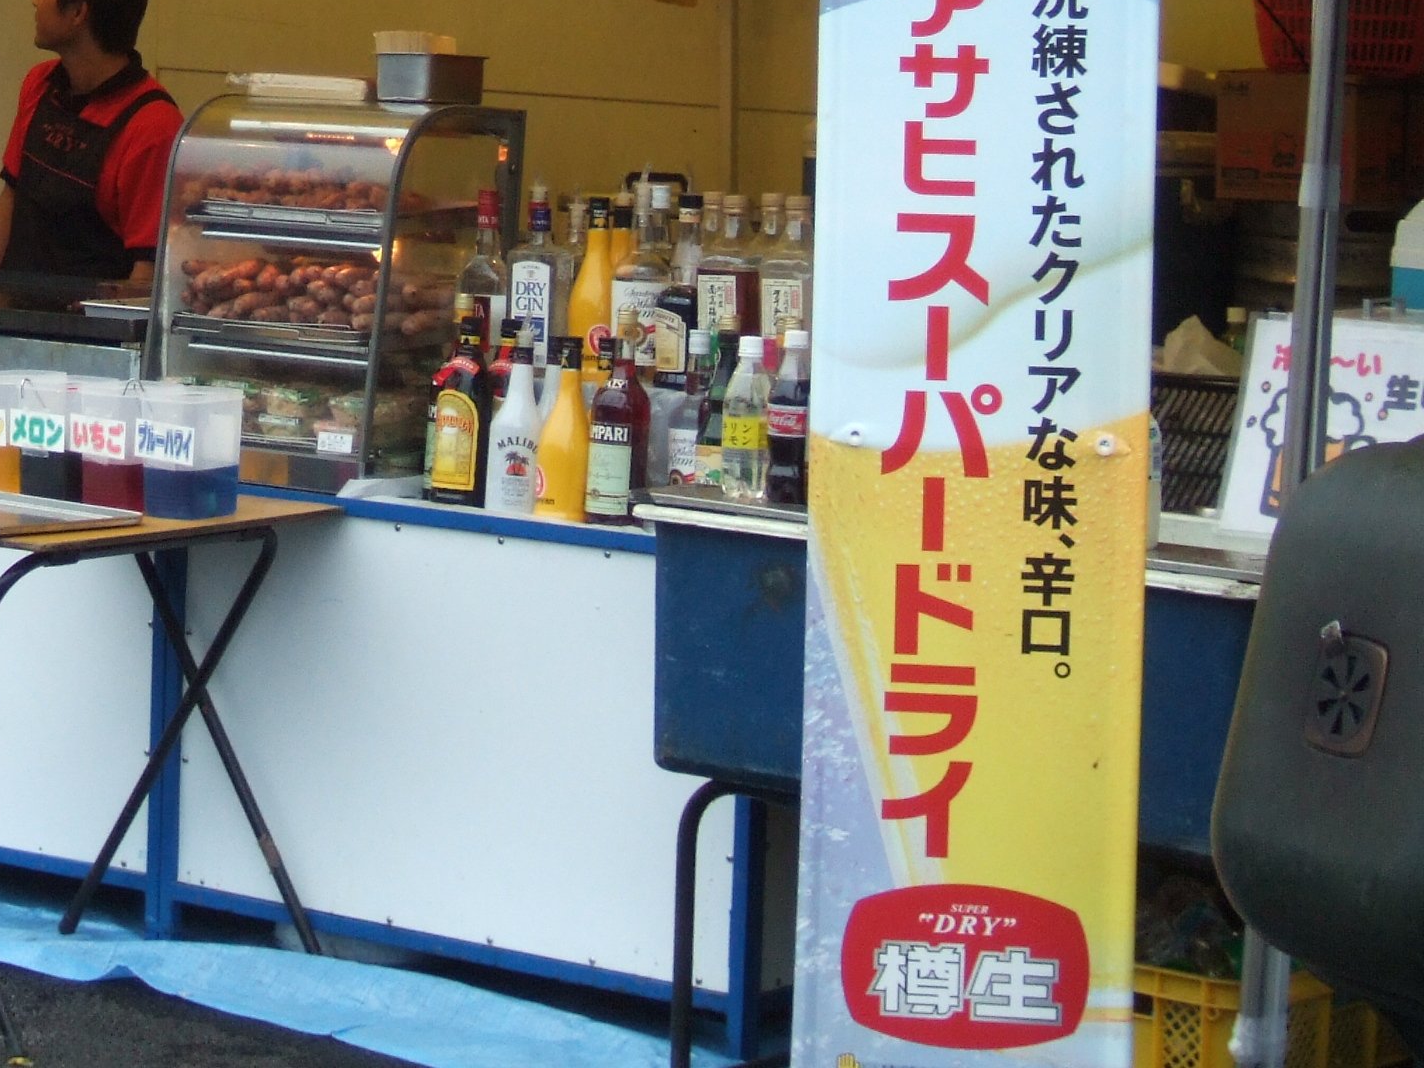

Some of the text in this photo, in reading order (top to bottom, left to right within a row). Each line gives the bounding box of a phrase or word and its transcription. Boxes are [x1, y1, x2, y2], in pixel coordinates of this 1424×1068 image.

[515, 282, 548, 296] DRY
[515, 296, 545, 312] GIN
[11, 413, 64, 447] メロン
[72, 420, 125, 456] いちご
[137, 420, 193, 460] ブルーハワイ
[950, 902, 990, 915] SUPER
[866, 940, 1062, 1026] 樽生
